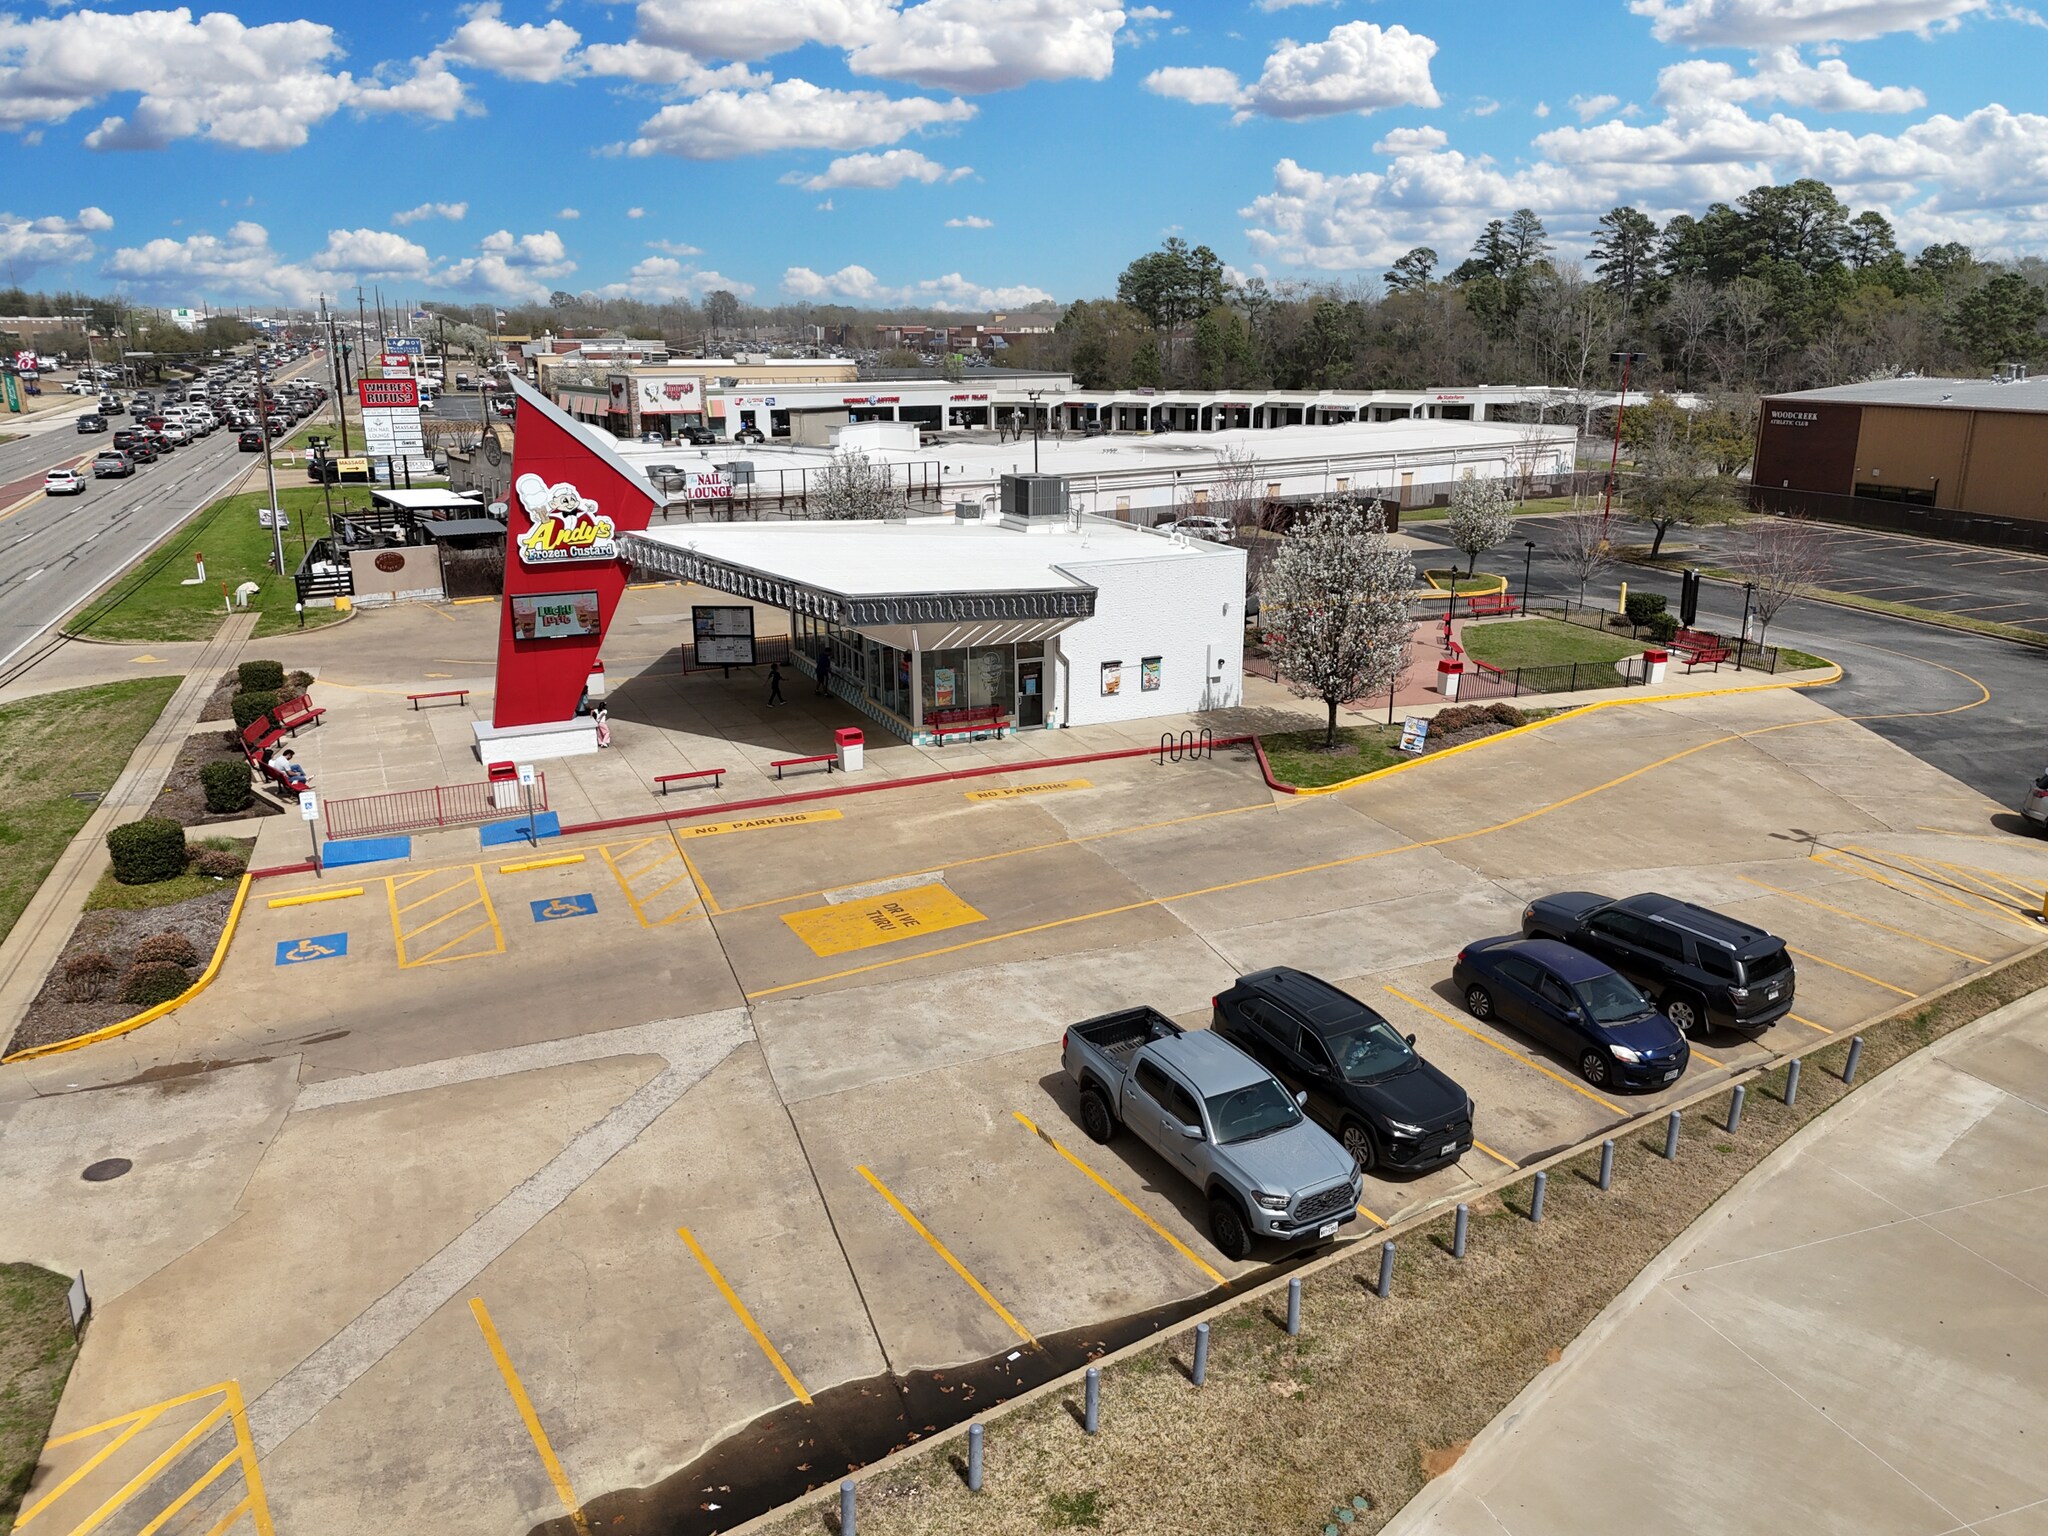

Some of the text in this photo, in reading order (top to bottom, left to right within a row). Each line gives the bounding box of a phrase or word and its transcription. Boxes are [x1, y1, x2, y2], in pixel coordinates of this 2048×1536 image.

[363, 382, 413, 392] WHERE'S
[366, 392, 414, 404] RUFUS?
[1771, 411, 1818, 420] WOODCREEK
[697, 474, 721, 485] NAIL
[687, 485, 733, 499] LOUNGE
[523, 518, 611, 551] Andy's
[528, 544, 614, 560] Frozen Custard
[974, 783, 1068, 799] NO PARKING
[695, 814, 807, 835] NO PARKING
[866, 909, 897, 931] THRU
[882, 902, 921, 928] DRIVE
